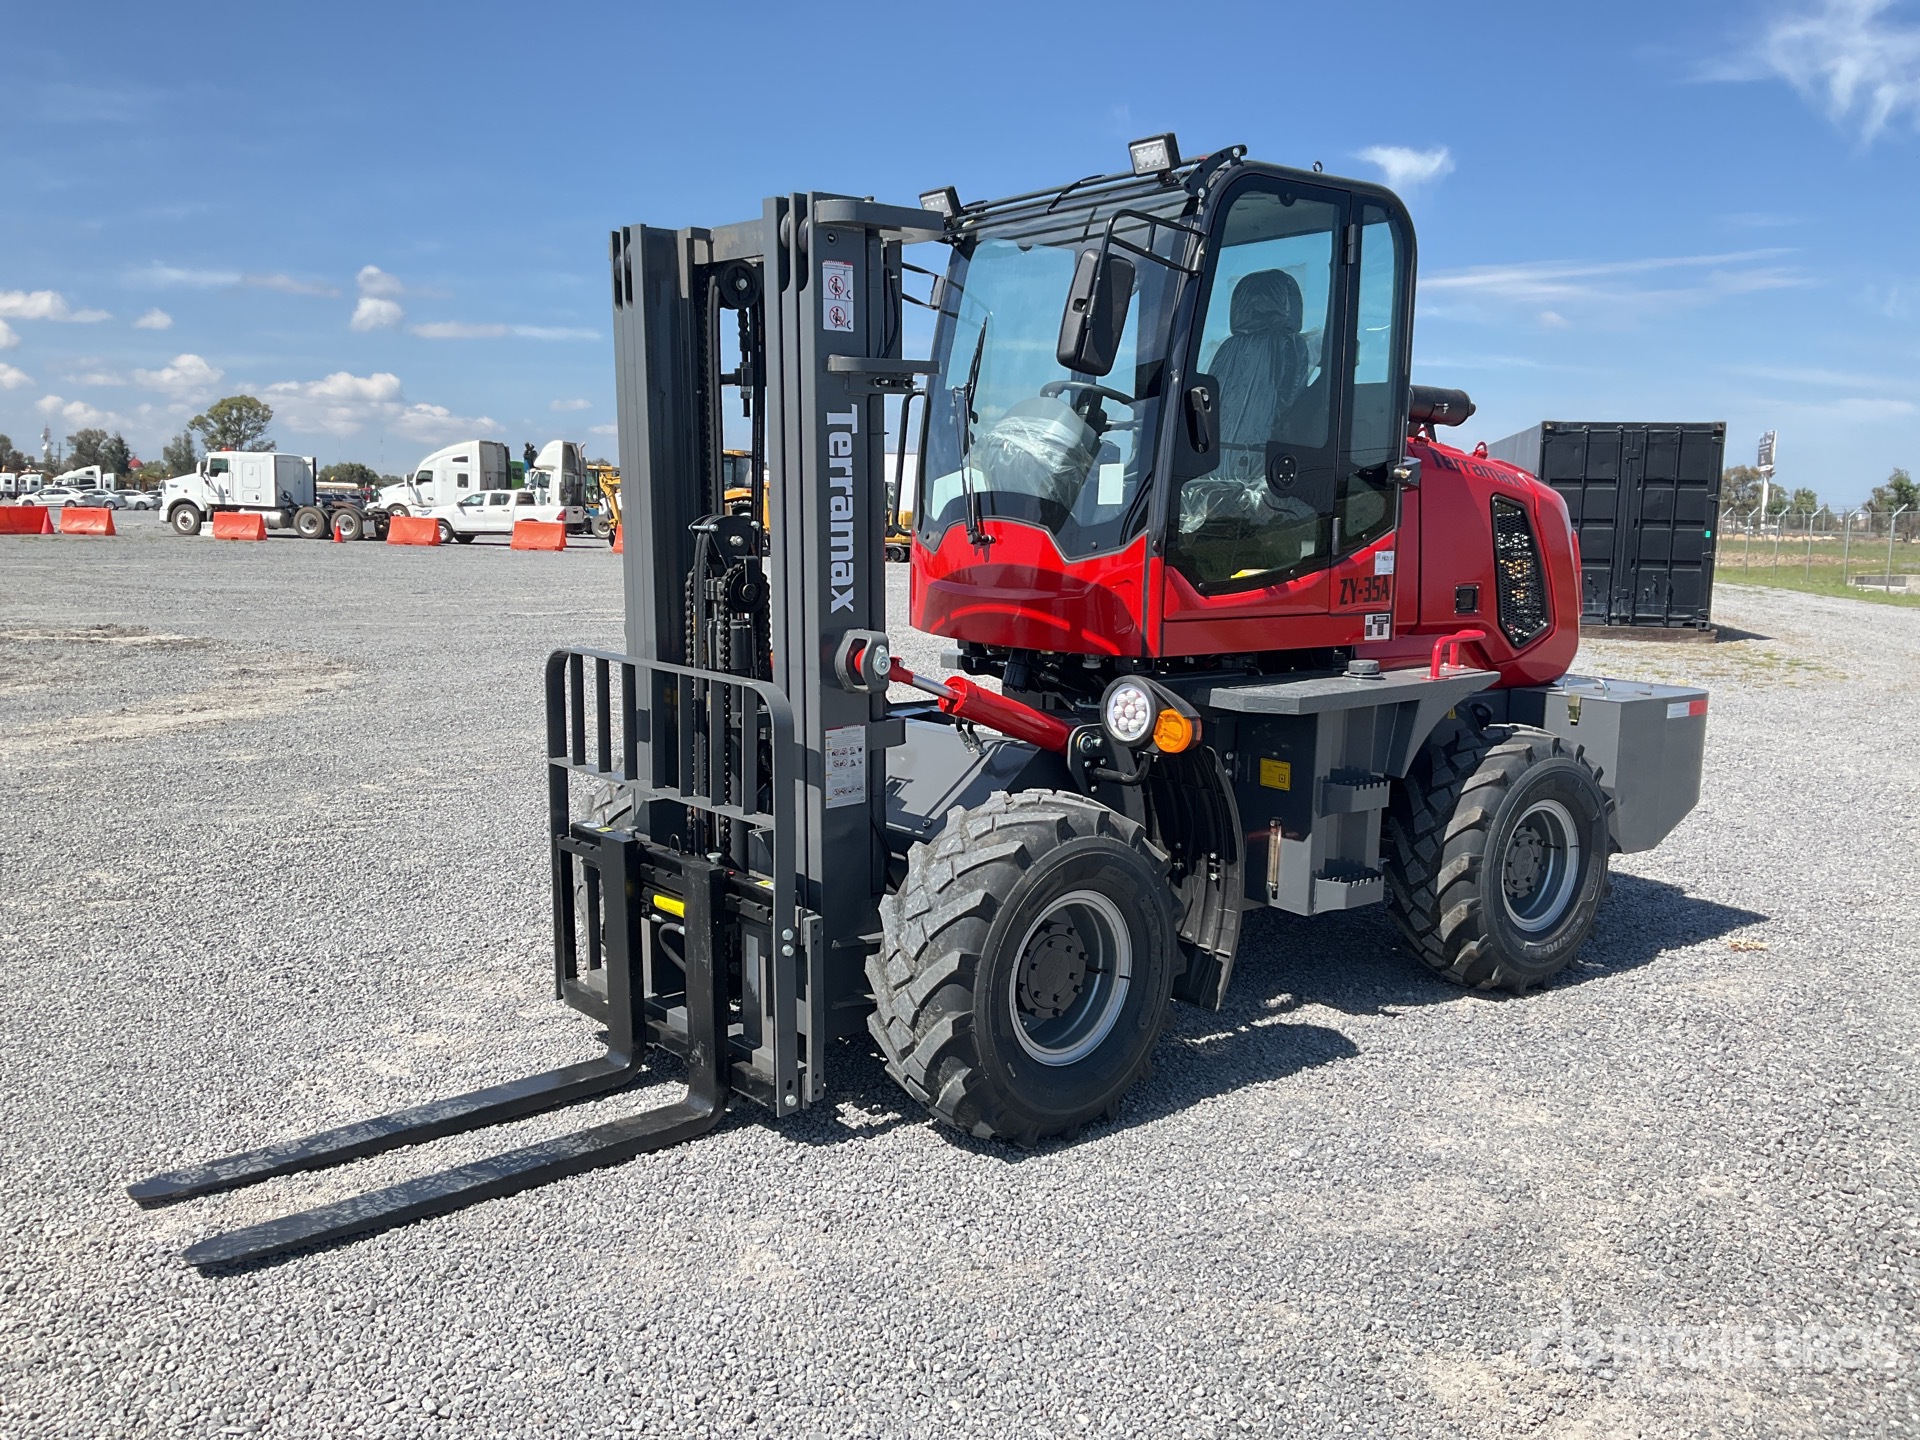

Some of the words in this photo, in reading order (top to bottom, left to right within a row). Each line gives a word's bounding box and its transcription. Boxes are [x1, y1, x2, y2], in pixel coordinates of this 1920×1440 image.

[1427, 447, 1523, 487] Terramax
[826, 403, 858, 614] Terramax
[1339, 576, 1390, 605] ZY-35A
